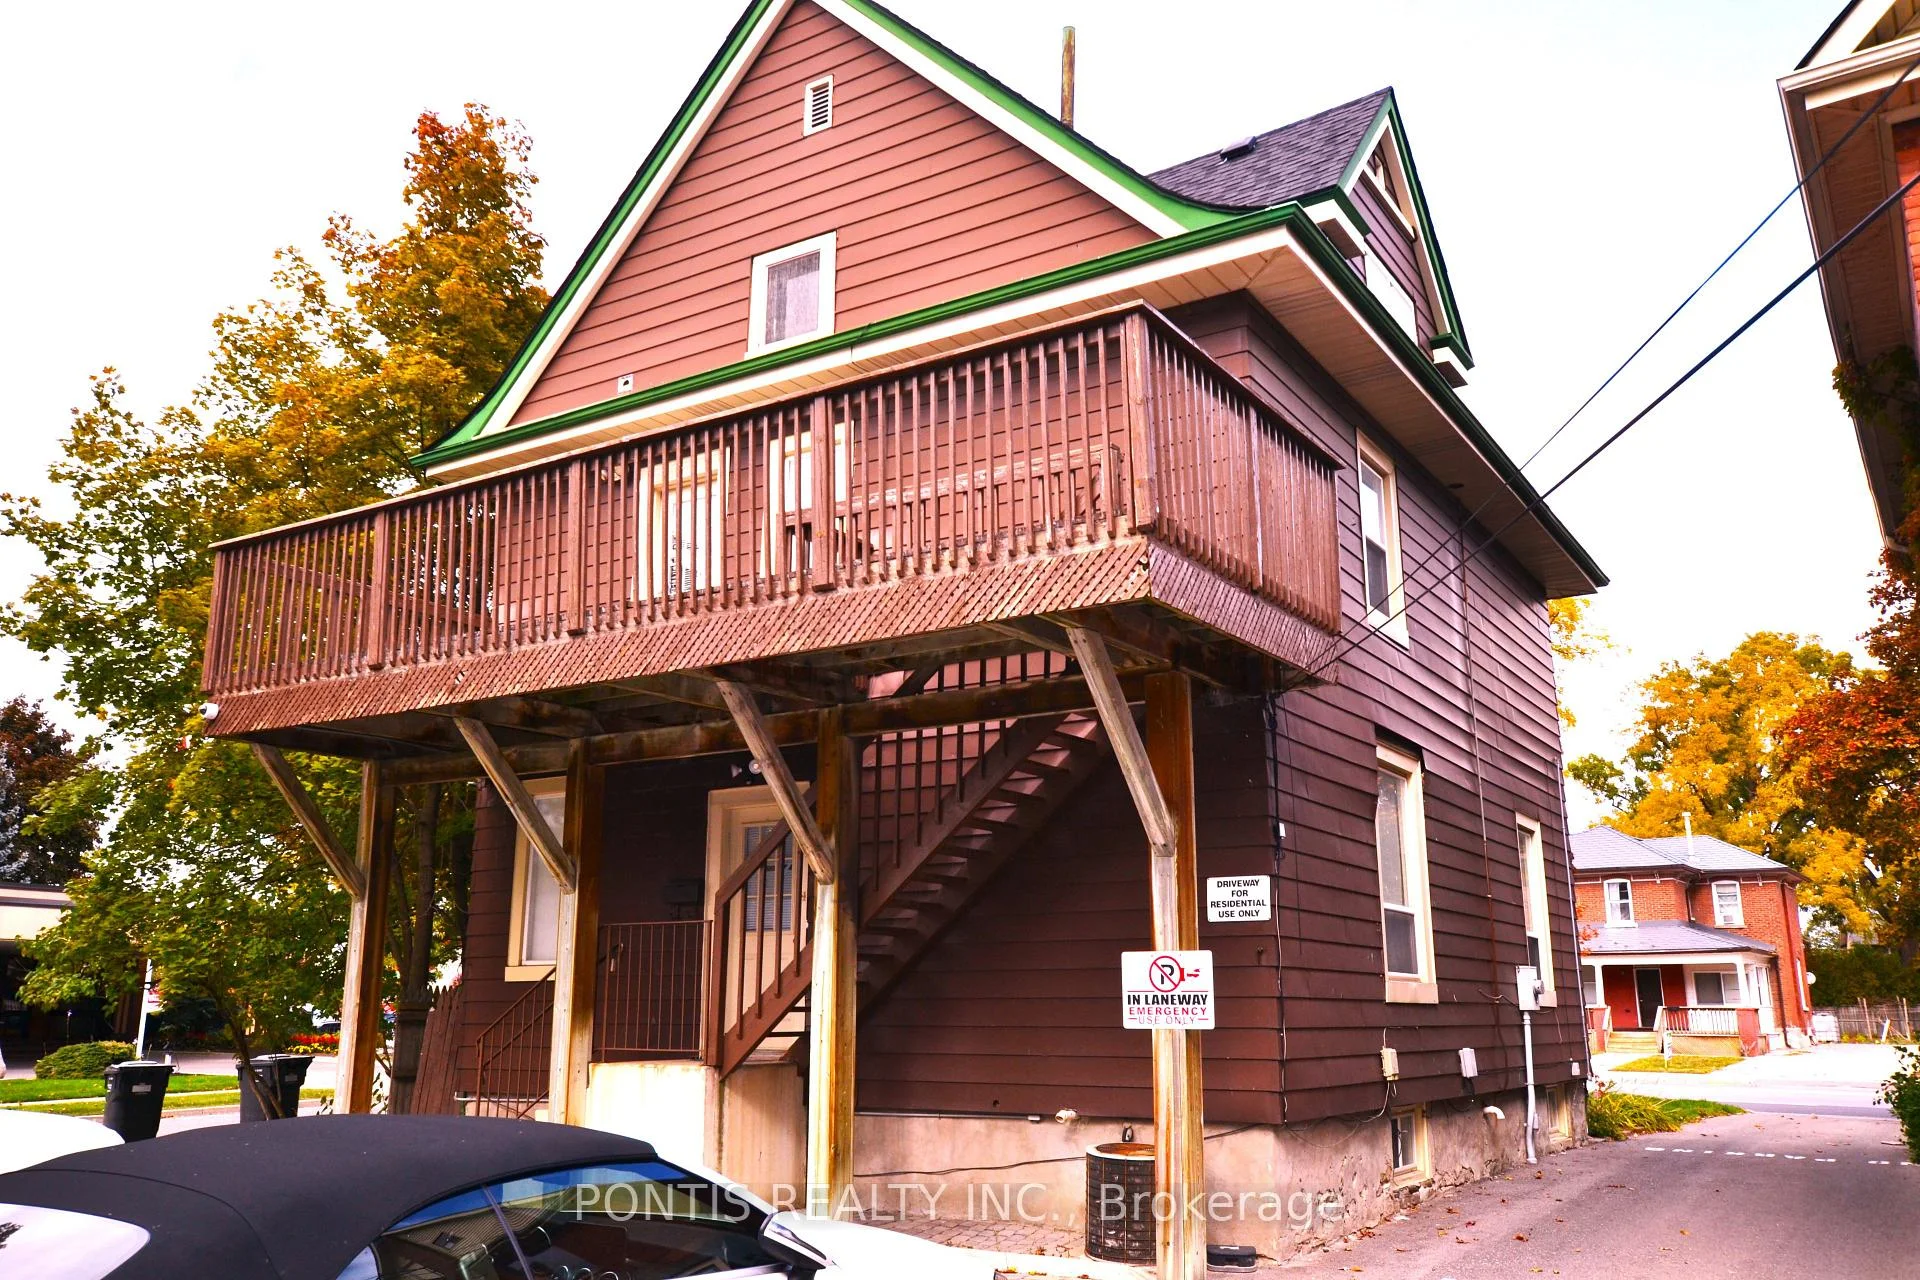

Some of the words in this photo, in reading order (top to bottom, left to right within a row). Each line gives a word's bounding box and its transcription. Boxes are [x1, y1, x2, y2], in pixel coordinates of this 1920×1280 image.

[1217, 879, 1260, 888] DRIVEWAY
[1231, 889, 1249, 897] FOR
[1210, 899, 1267, 908] RESIDENTIAL
[1218, 910, 1235, 918] USE
[1238, 909, 1260, 917] ONLY
[1127, 994, 1141, 1005] IN
[1144, 994, 1208, 1005] LANEWAY
[1129, 1007, 1207, 1015] EMERGENCY
[1138, 1016, 1160, 1025] USE
[1165, 1016, 1196, 1025] ONLY
